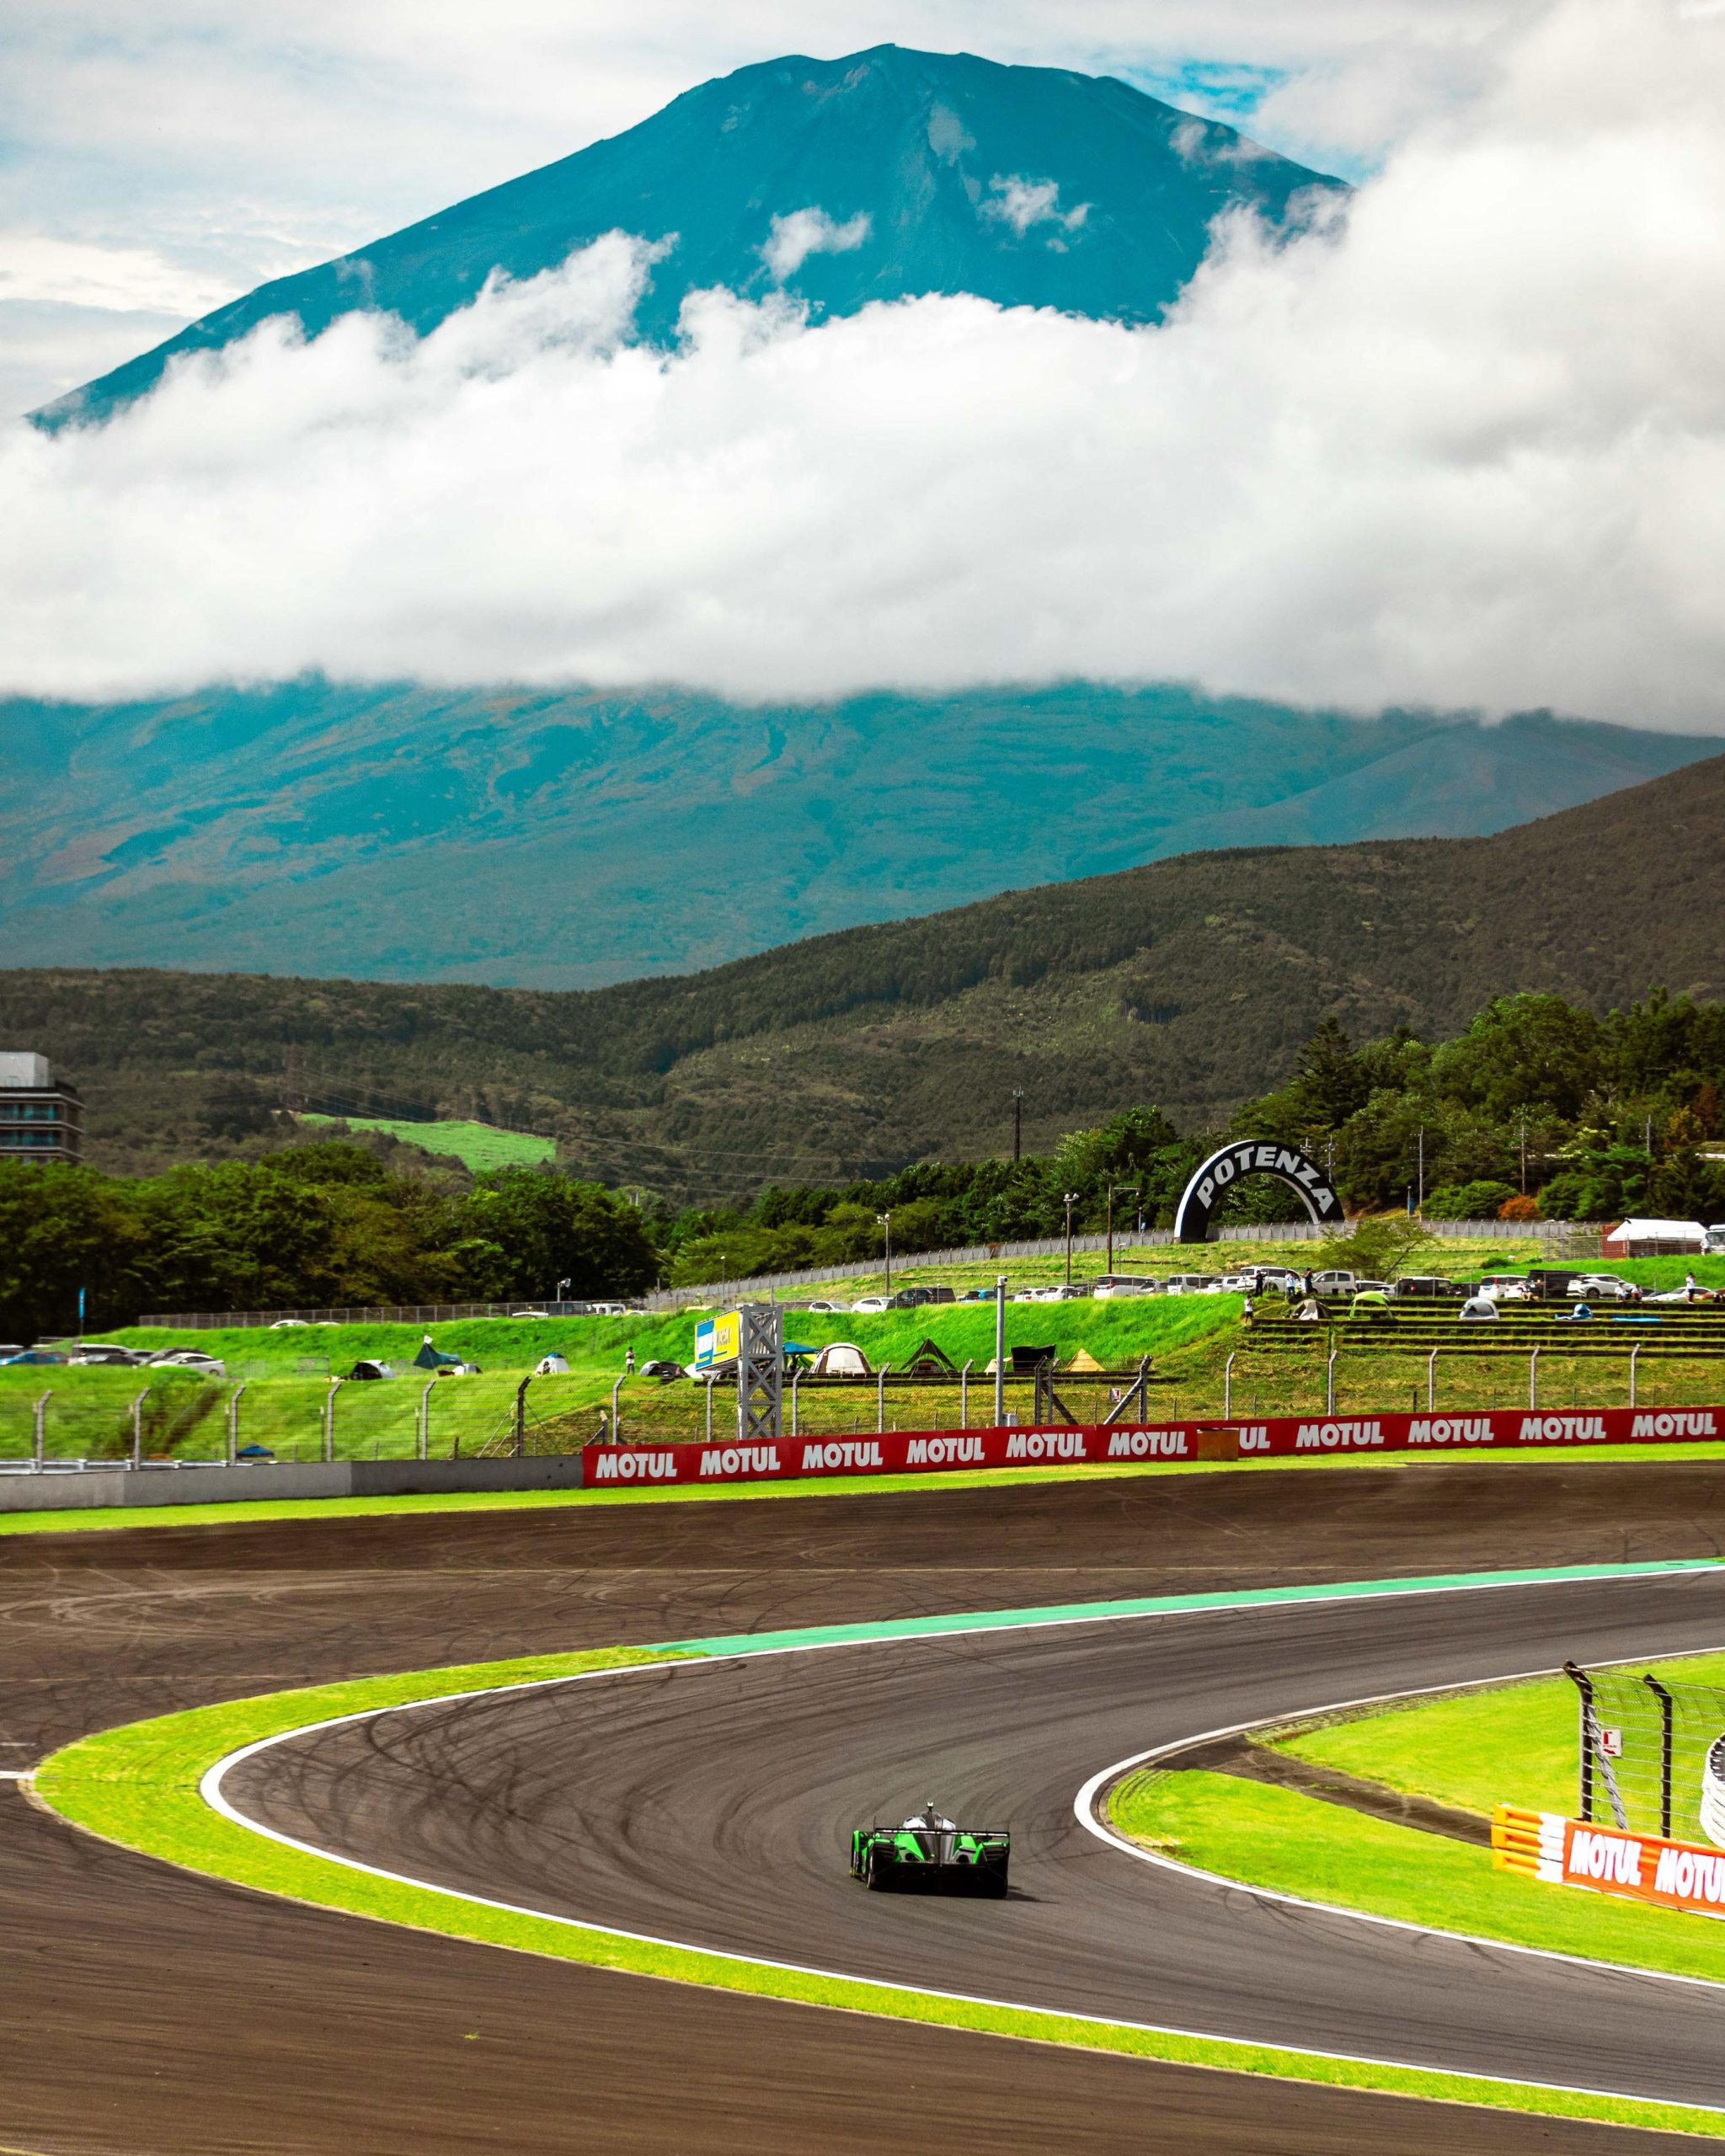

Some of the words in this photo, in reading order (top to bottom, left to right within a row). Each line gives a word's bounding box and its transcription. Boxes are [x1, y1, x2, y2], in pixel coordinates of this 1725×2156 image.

[1196, 1146, 1334, 1214] POTENZA
[596, 1454, 676, 1478] MOTUL
[700, 1447, 780, 1475] MOTUL
[803, 1443, 883, 1469] MOTUL
[906, 1438, 985, 1463] MOTUL
[1007, 1433, 1086, 1457] MOTUL
[1108, 1432, 1188, 1455] MOTUL
[1296, 1422, 1384, 1447] MOTUL
[1408, 1419, 1493, 1442] MOTUL
[1520, 1417, 1605, 1439] MOTUL
[1632, 1413, 1716, 1437] MOTUL
[1568, 1830, 1642, 1886] MOTUL
